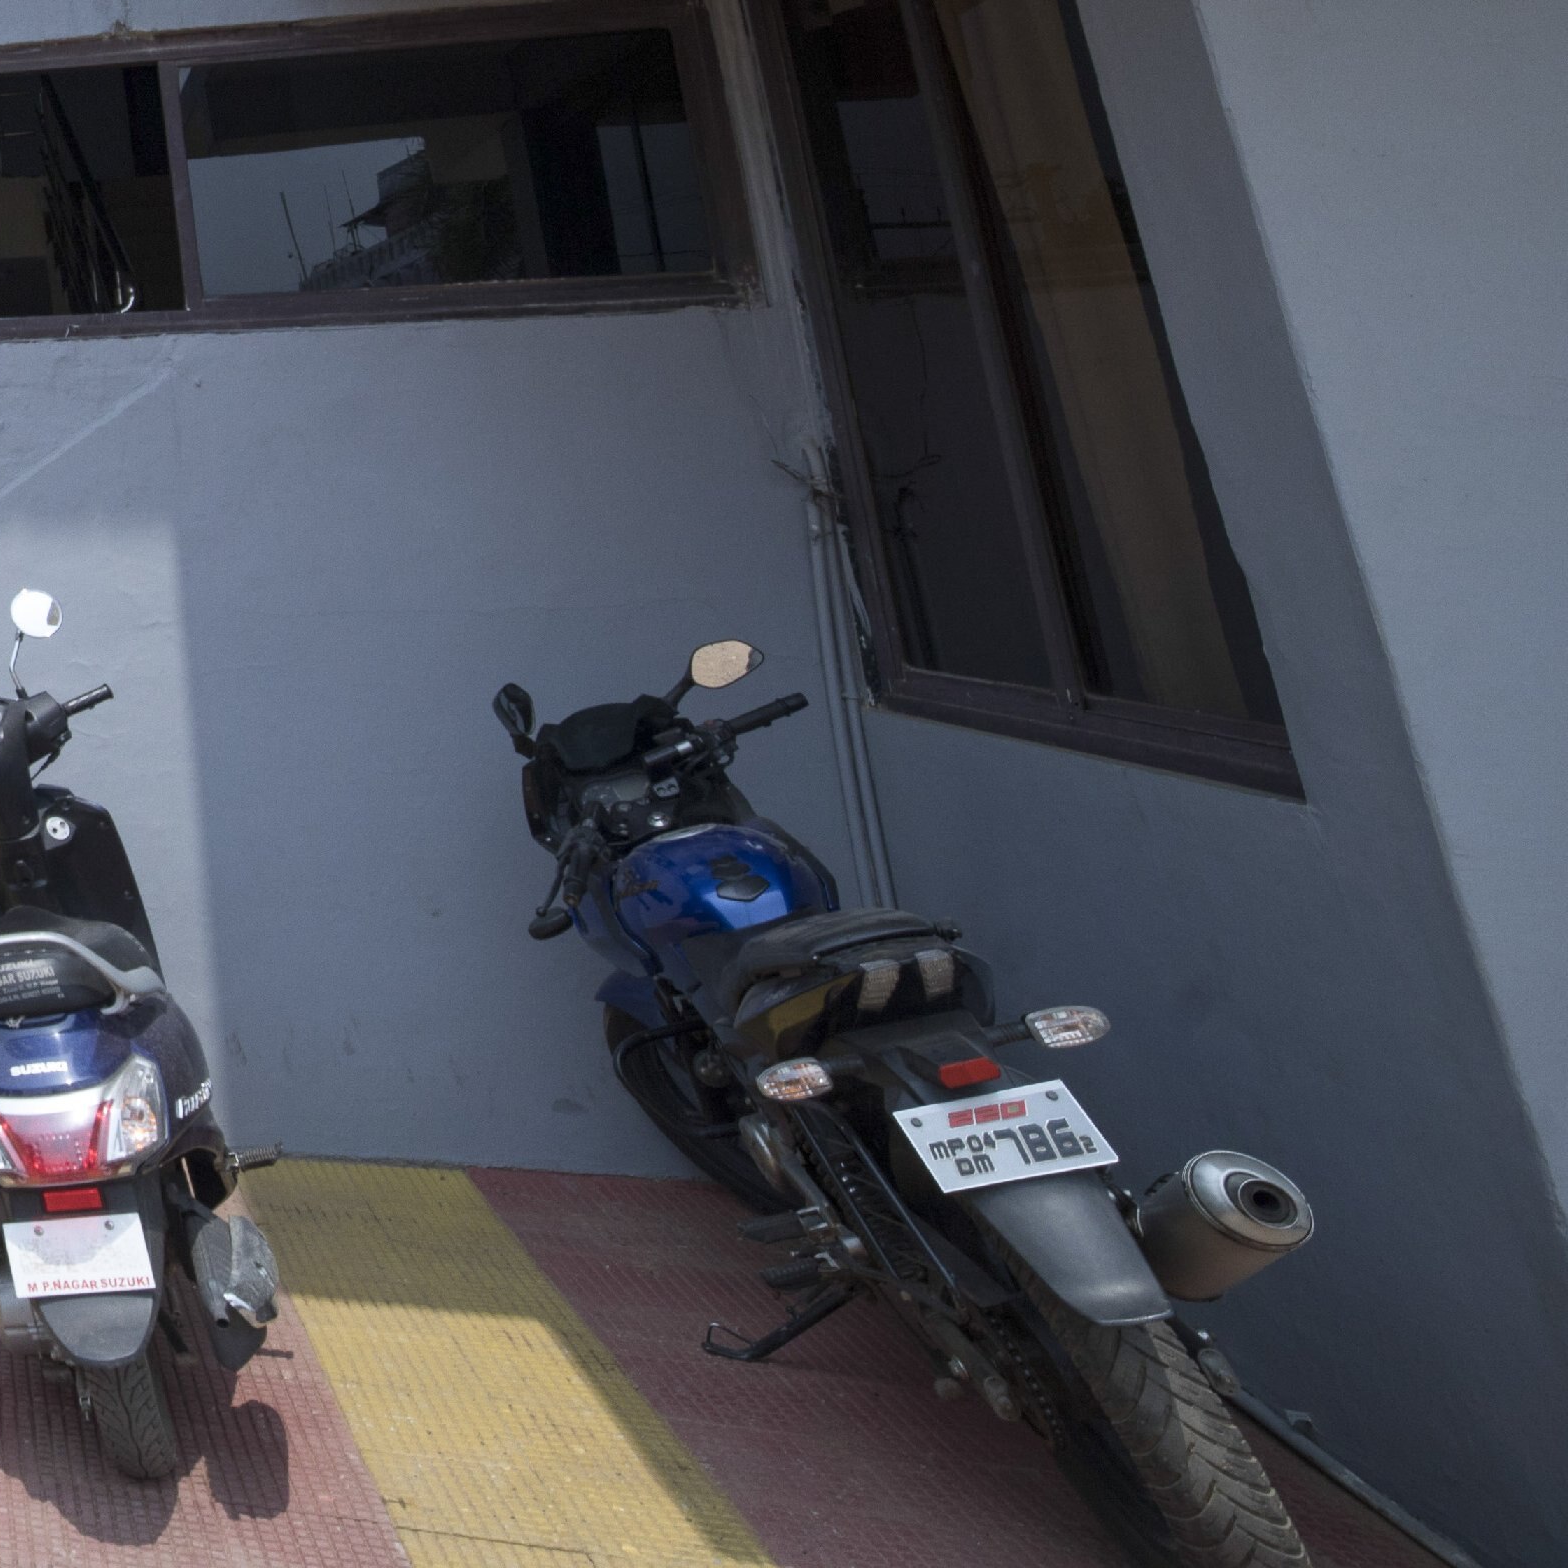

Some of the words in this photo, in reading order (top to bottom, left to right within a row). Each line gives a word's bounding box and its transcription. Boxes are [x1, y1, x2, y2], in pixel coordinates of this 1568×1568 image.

[17, 964, 56, 983] SUZUKI
[955, 1154, 996, 1177] DM
[101, 1276, 151, 1289] SUZUKI
